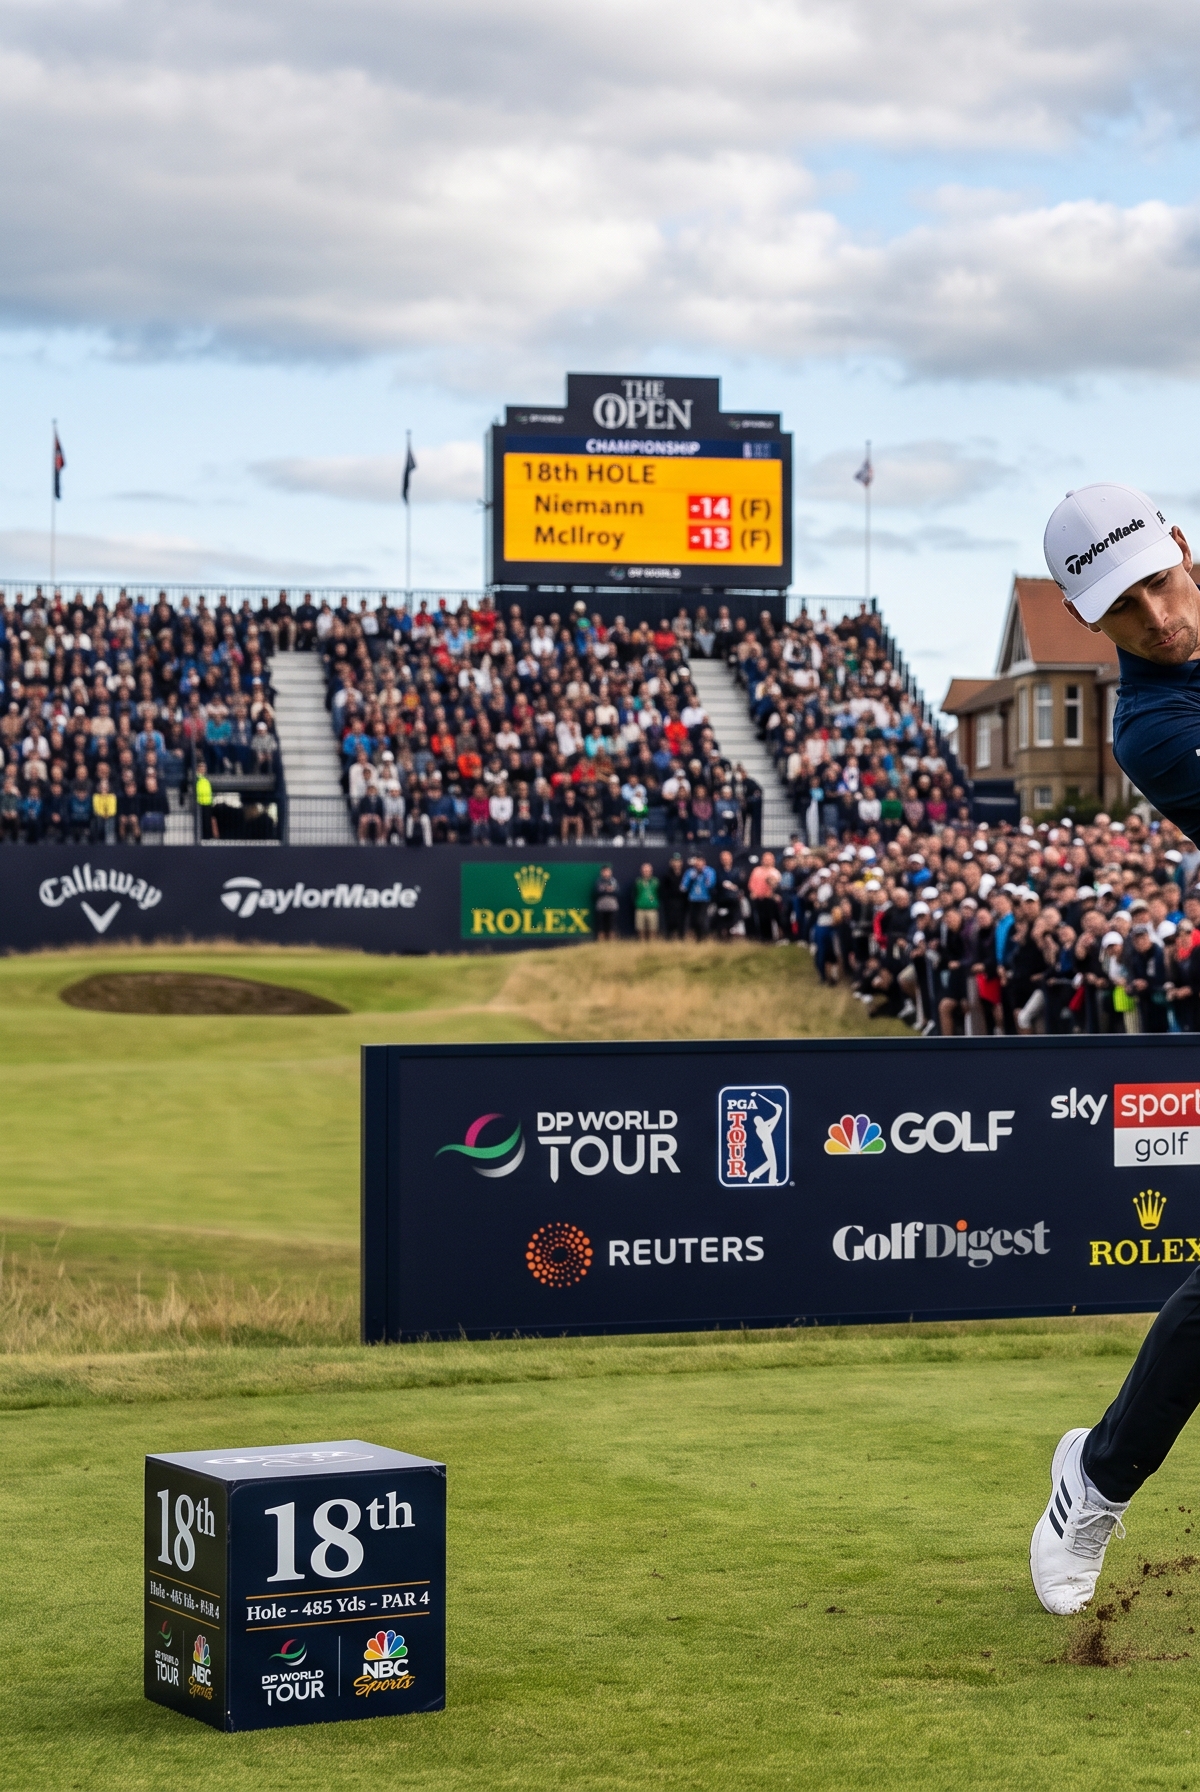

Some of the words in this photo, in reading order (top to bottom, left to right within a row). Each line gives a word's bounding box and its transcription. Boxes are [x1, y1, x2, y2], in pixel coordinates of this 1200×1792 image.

[622, 380, 664, 398] THE
[593, 394, 693, 430] OPEN
[586, 438, 700, 455] CHAMPIONSHIP
[523, 462, 578, 482] 18th
[588, 464, 656, 484] HOLE
[535, 495, 644, 515] Niemann
[690, 498, 730, 518] -14
[740, 500, 771, 520] (F)
[535, 526, 624, 549] McIlroy
[690, 528, 730, 548] -13
[740, 530, 771, 550] (F)
[1065, 519, 1145, 574] TaylorMade
[38, 862, 162, 910] Callaway
[220, 876, 419, 918] TaylorMade
[471, 908, 591, 934] ROLEX
[727, 1099, 758, 1109] PGA
[1050, 1087, 1108, 1125] sky
[537, 1111, 573, 1131] DP
[578, 1110, 678, 1131] WORLD
[890, 1110, 1016, 1153] GOLF
[538, 1133, 681, 1184] TOUR
[727, 1111, 748, 1178] TOUR
[1134, 1132, 1190, 1162] golf
[609, 1236, 765, 1266] REUTERS
[157, 1489, 216, 1572] 18th
[265, 1491, 415, 1582] 18th
[247, 1603, 287, 1621] Hole
[302, 1600, 332, 1616] 485
[338, 1597, 366, 1614] Yds
[382, 1594, 416, 1609] PAR
[420, 1592, 430, 1605] 4
[262, 1674, 278, 1684] DP
[281, 1670, 324, 1682] WORLD
[363, 1658, 409, 1676] NBC
[261, 1681, 325, 1706] TOUR
[353, 1675, 415, 1698] Sports
